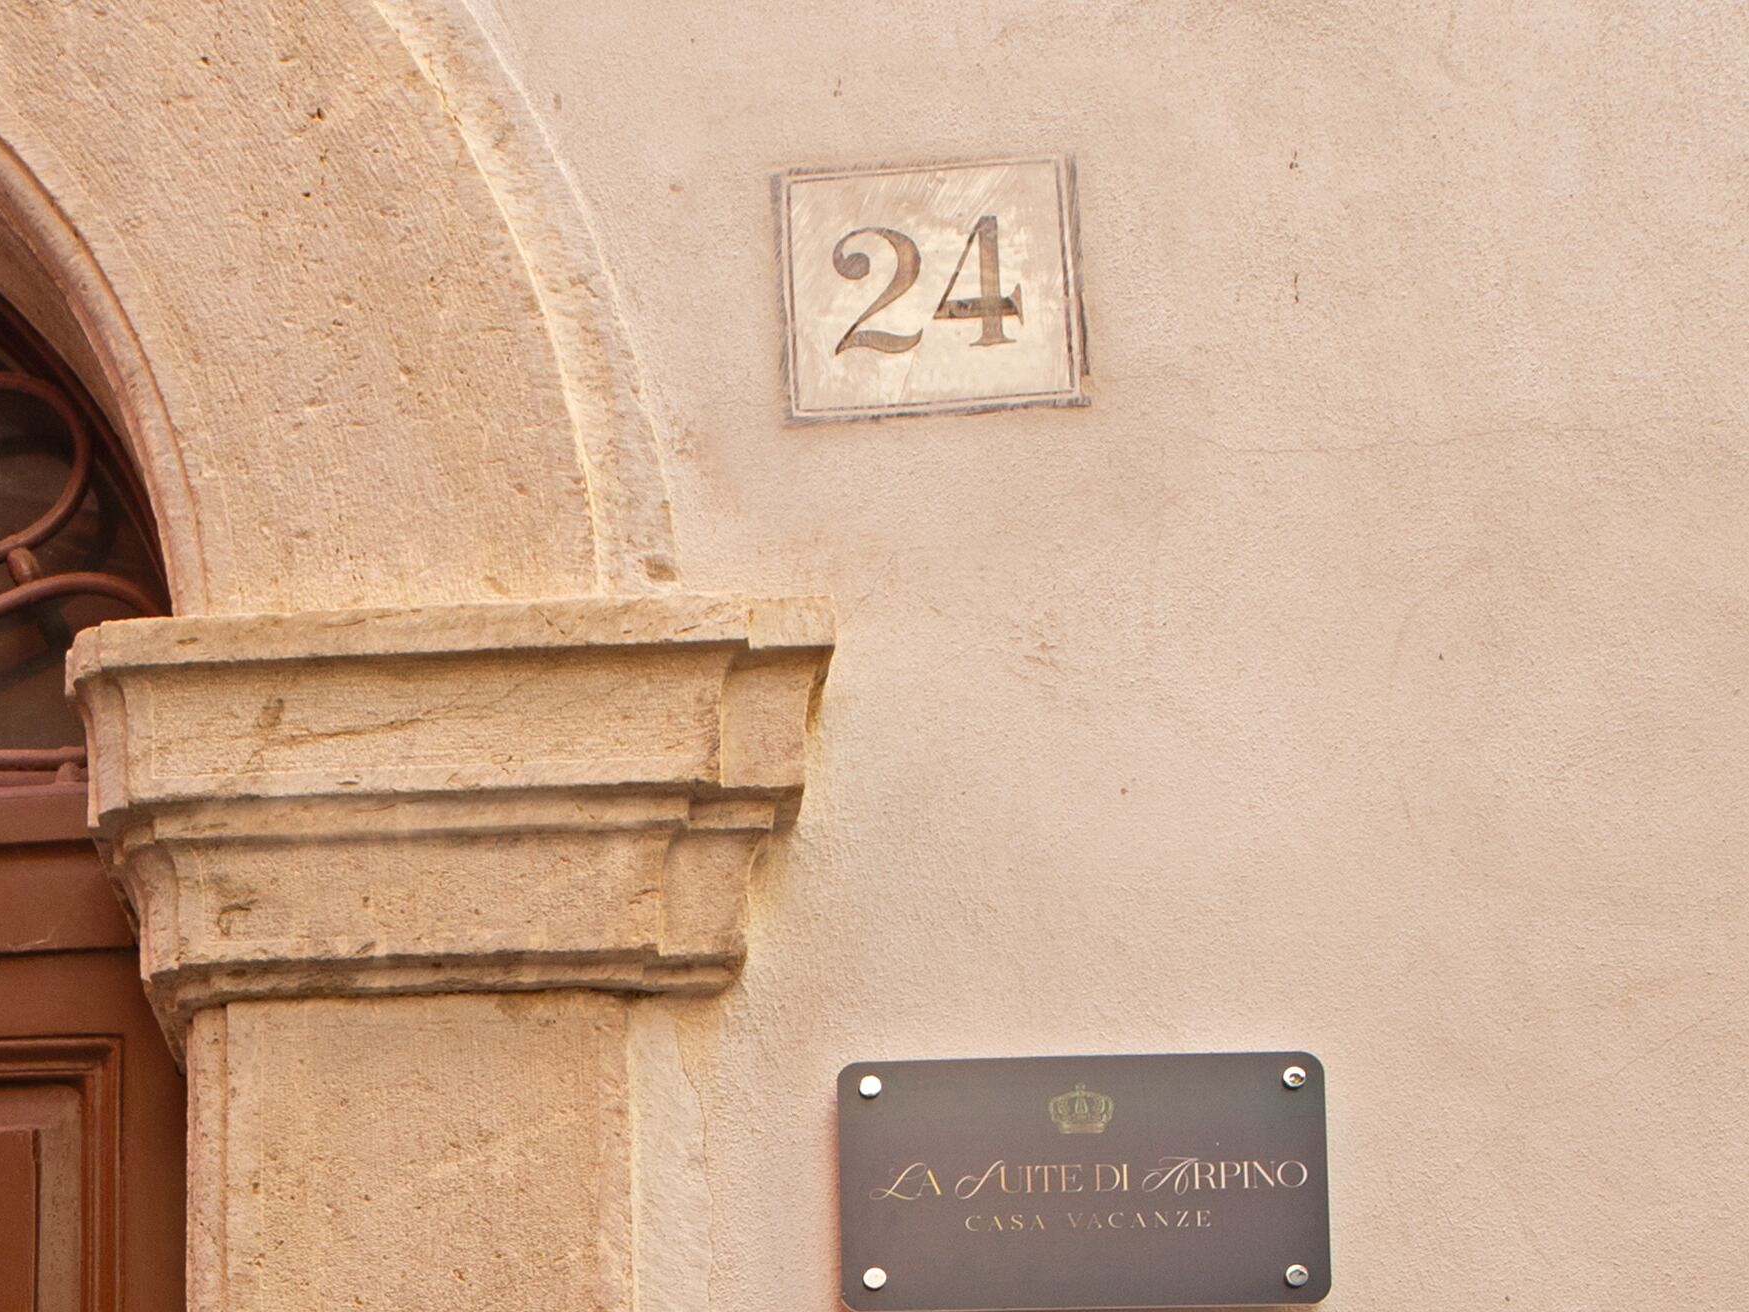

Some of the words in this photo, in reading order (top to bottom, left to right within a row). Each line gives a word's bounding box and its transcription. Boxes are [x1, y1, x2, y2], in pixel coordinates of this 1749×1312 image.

[832, 214, 1025, 357] 24
[869, 1161, 943, 1201] LA
[954, 1158, 1084, 1200] SUITE
[1094, 1162, 1130, 1193] DI
[1141, 1156, 1309, 1197] ARPINO
[964, 1212, 1047, 1233] CASA
[1067, 1208, 1213, 1232] VACANZE
